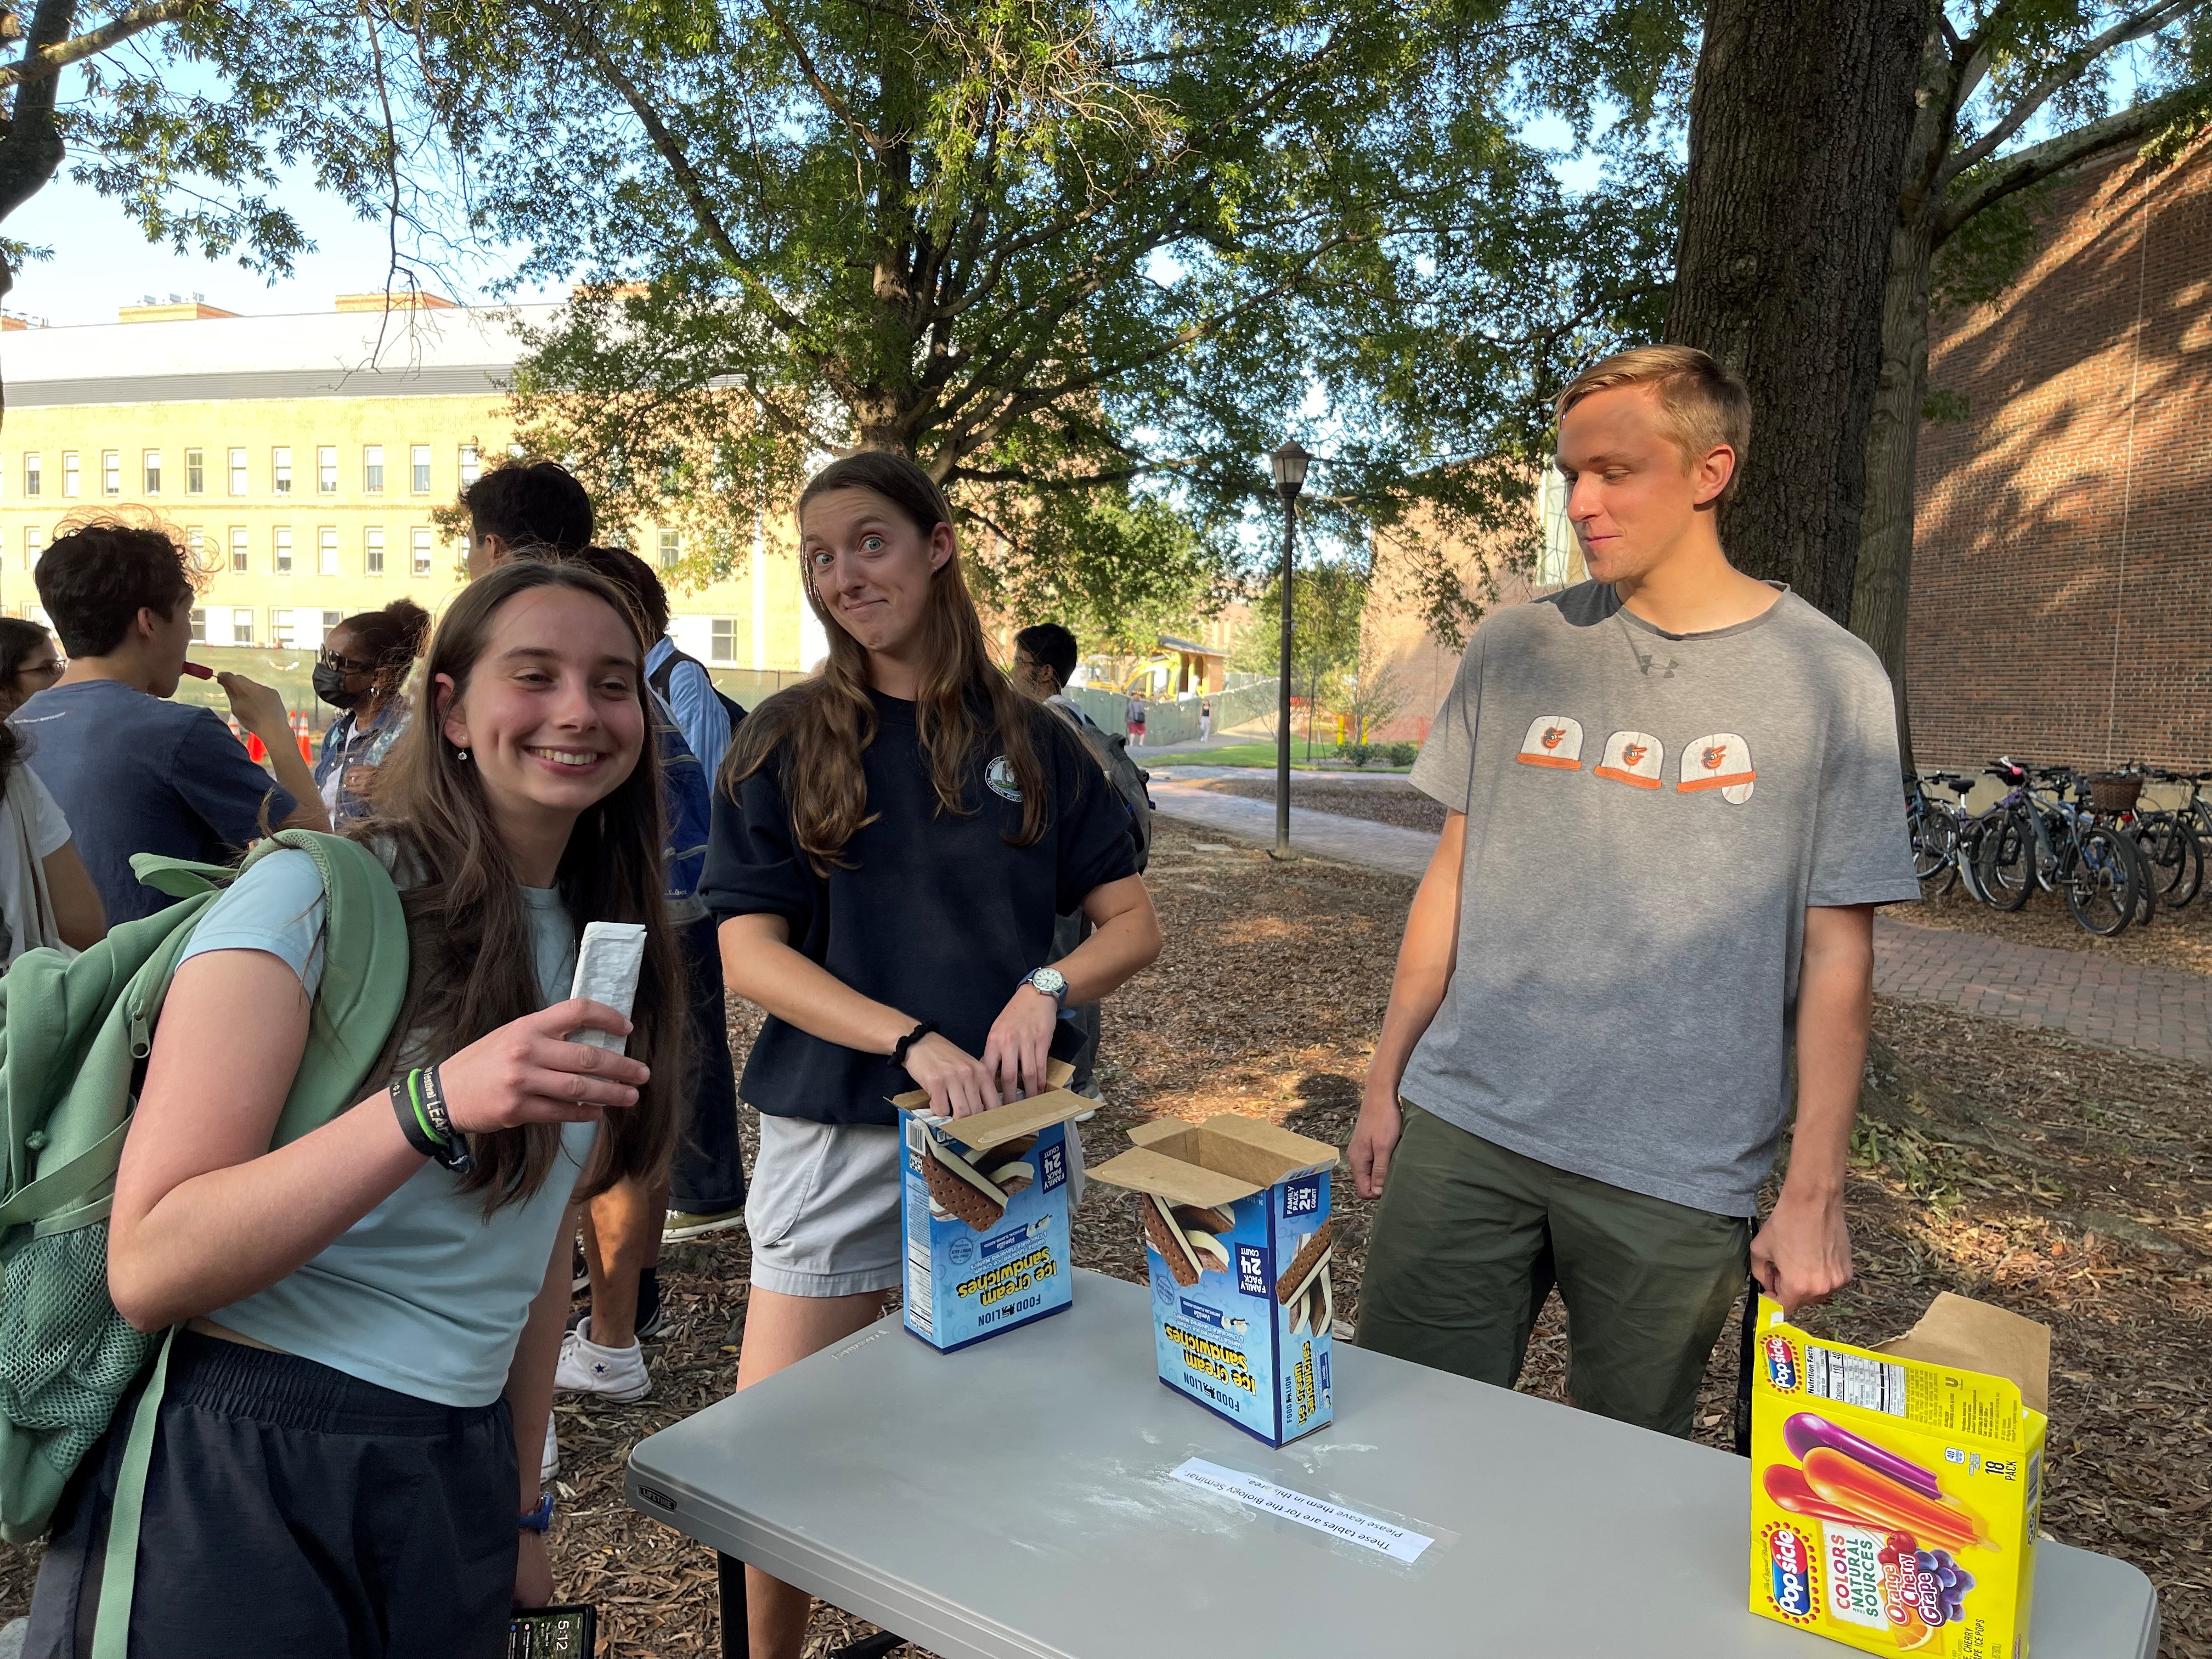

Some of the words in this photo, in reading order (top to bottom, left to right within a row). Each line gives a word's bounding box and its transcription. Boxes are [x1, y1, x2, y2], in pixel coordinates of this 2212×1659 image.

[1044, 1146, 1059, 1159] COUNT
[1044, 1152, 1061, 1174] 24
[1044, 1172, 1065, 1190] FAMILY
[1047, 1167, 1062, 1181] PACK
[1299, 1188, 1311, 1210] 24
[996, 1237, 1015, 1249] Vanilla
[1017, 1233, 1042, 1249] Chocolate
[1028, 1239, 1045, 1250] Vanilla
[991, 1246, 1016, 1261] Flavored
[1003, 1248, 1028, 1261] Flavored
[1240, 1248, 1259, 1257] COUNT
[970, 1254, 991, 1270] Wafers
[974, 1263, 992, 1274] Cream
[1240, 1256, 1261, 1276] 24
[956, 1246, 1051, 1299] Sandwiches
[1034, 1261, 1058, 1282] Ice
[1244, 1275, 1262, 1285] PACK
[980, 1273, 1031, 1306] Cream
[1240, 1280, 1266, 1294] FAMILY
[1017, 1294, 1041, 1312] FOOD
[978, 1309, 1001, 1327] LION
[1194, 1310, 1210, 1322] Vanilla
[1213, 1328, 1238, 1340] Chocolate
[1164, 1323, 1248, 1373] Sandwiches
[1224, 1338, 1242, 1349] Vanilla
[1183, 1349, 1229, 1385] Cream
[1769, 1339, 1791, 1388] Popsicle
[1833, 1364, 1842, 1374] 110
[1183, 1372, 1204, 1392] LION
[1231, 1370, 1256, 1396] Ice
[1294, 1362, 1305, 1404] Cream
[1302, 1341, 1316, 1416] Sandwiches
[1216, 1390, 1240, 1413] FOOD
[1297, 1404, 1306, 1426] Ice
[1946, 1450, 1955, 1459] 40
[1985, 1461, 2005, 1474] 18
[2005, 1460, 2017, 1481] PACK
[1184, 1470, 1226, 1491] Seminar.
[1248, 1479, 1272, 1491] area.
[643, 1488, 672, 1508] LIFETIME
[1226, 1486, 1264, 1504] Biology
[1274, 1488, 1292, 1499] this
[1266, 1501, 1284, 1511] the
[1284, 1509, 1301, 1518] for
[1306, 1500, 1334, 1514] them
[1303, 1514, 1322, 1523] are
[1336, 1511, 1365, 1525] leave
[1323, 1521, 1356, 1537] tables
[1367, 1521, 1403, 1538] Please
[1358, 1534, 1389, 1551] These
[1774, 1530, 1803, 1615] Popsicle
[1831, 1534, 1850, 1610] COLORS
[1846, 1539, 1864, 1607] NATURAL
[1860, 1540, 1878, 1617] SOURCES
[1898, 1555, 1920, 1606] Cherry
[1884, 1566, 1906, 1623] Orange
[1918, 1573, 1942, 1624] Grape
[556, 1620, 569, 1651] 5:12
[1974, 1619, 1985, 1636] POPS
[1963, 1627, 1973, 1653] CHERRY
[1974, 1637, 1984, 1647] ICE
